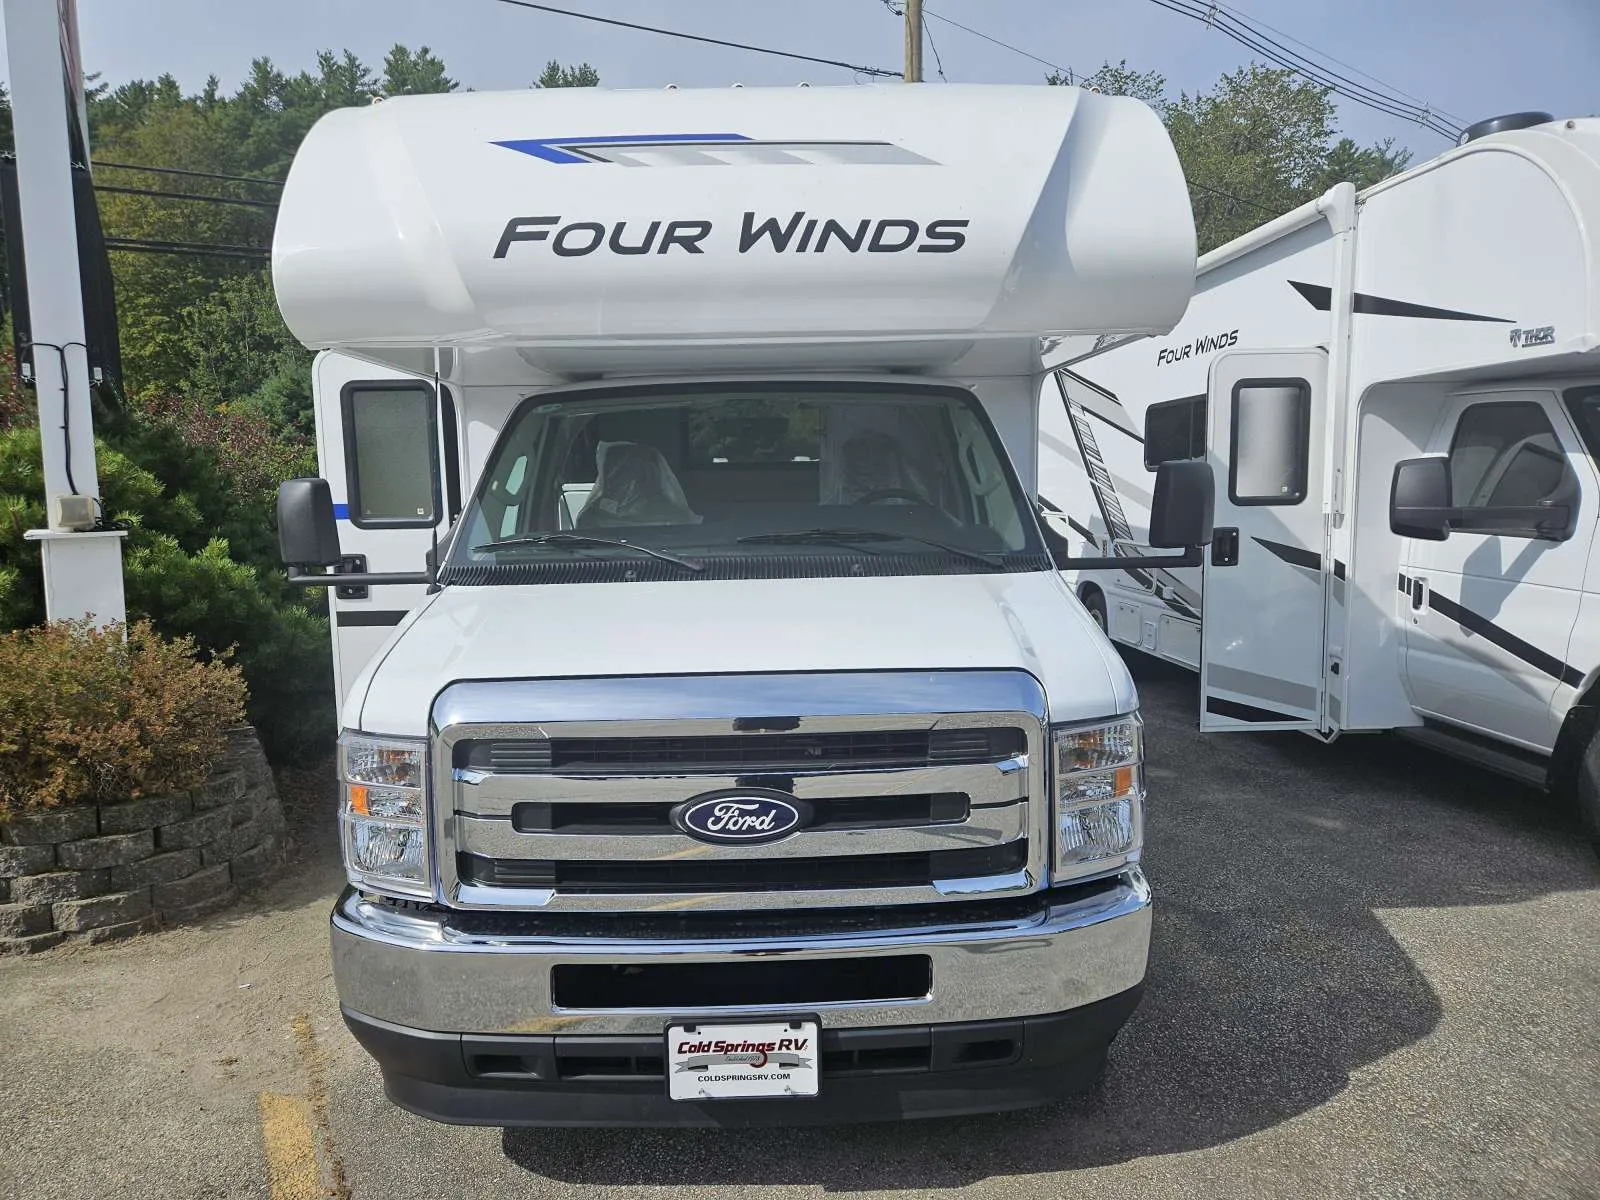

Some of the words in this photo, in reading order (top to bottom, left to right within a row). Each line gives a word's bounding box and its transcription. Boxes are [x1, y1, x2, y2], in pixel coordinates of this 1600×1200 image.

[1522, 326, 1555, 344] THOR
[707, 803, 777, 830] Ford
[677, 1040, 713, 1055] Cold
[713, 1040, 777, 1068] Springs
[777, 1038, 809, 1052] RV
[697, 1073, 791, 1082] COLDSPRINGSRV.COM
